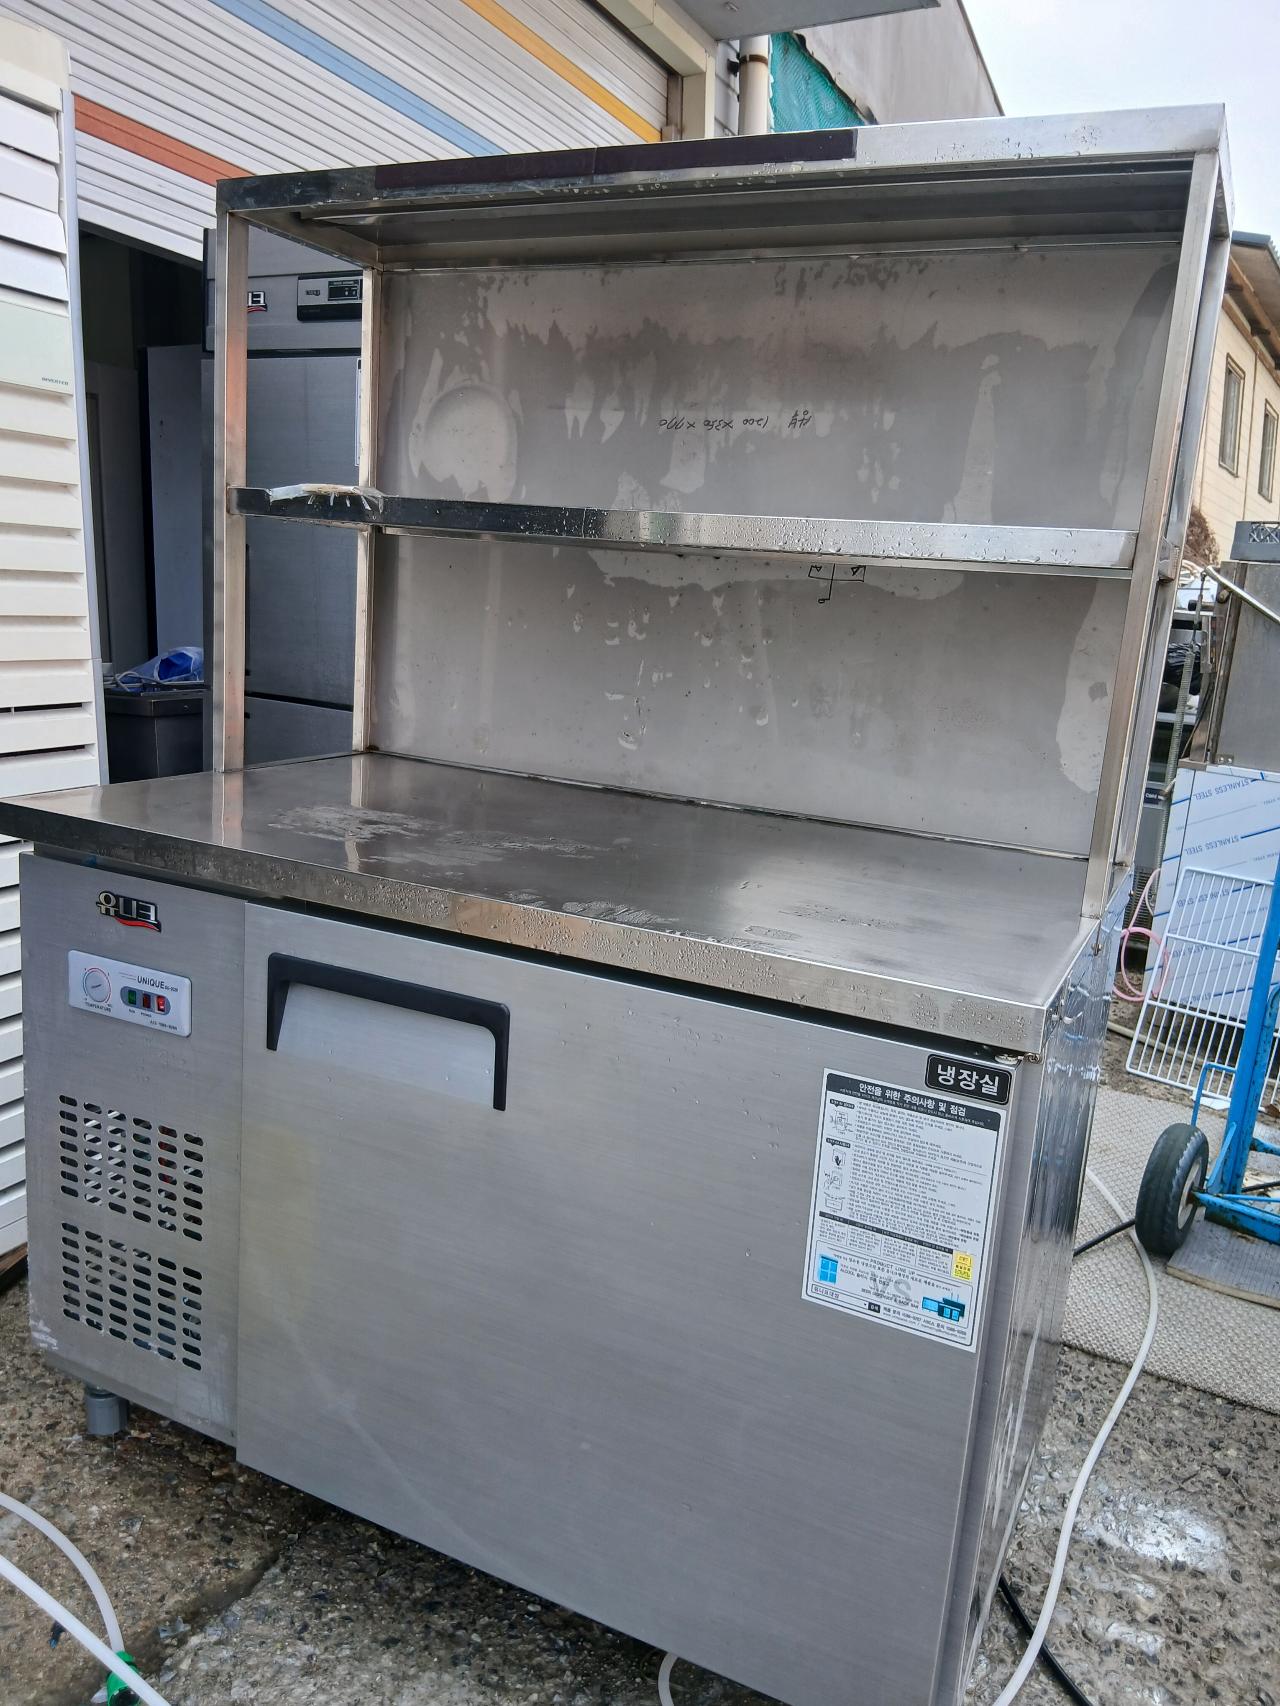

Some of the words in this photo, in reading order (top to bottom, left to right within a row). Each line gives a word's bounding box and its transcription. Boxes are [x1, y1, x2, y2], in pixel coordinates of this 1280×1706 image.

[742, 416, 769, 428] 1200
[1215, 778, 1251, 794] STAINLESS
[1193, 790, 1213, 800] STEEL
[1205, 834, 1240, 849] STAINLESS
[1184, 845, 1203, 855] STEEL
[137, 975, 165, 989] UNIQUE
[937, 1063, 1000, 1096] 냉장실
[858, 1082, 883, 1097] 안전을
[884, 1088, 900, 1101] 위한
[902, 1093, 935, 1109] 주의사항
[937, 1101, 946, 1112] 및
[948, 1104, 966, 1117] 점검
